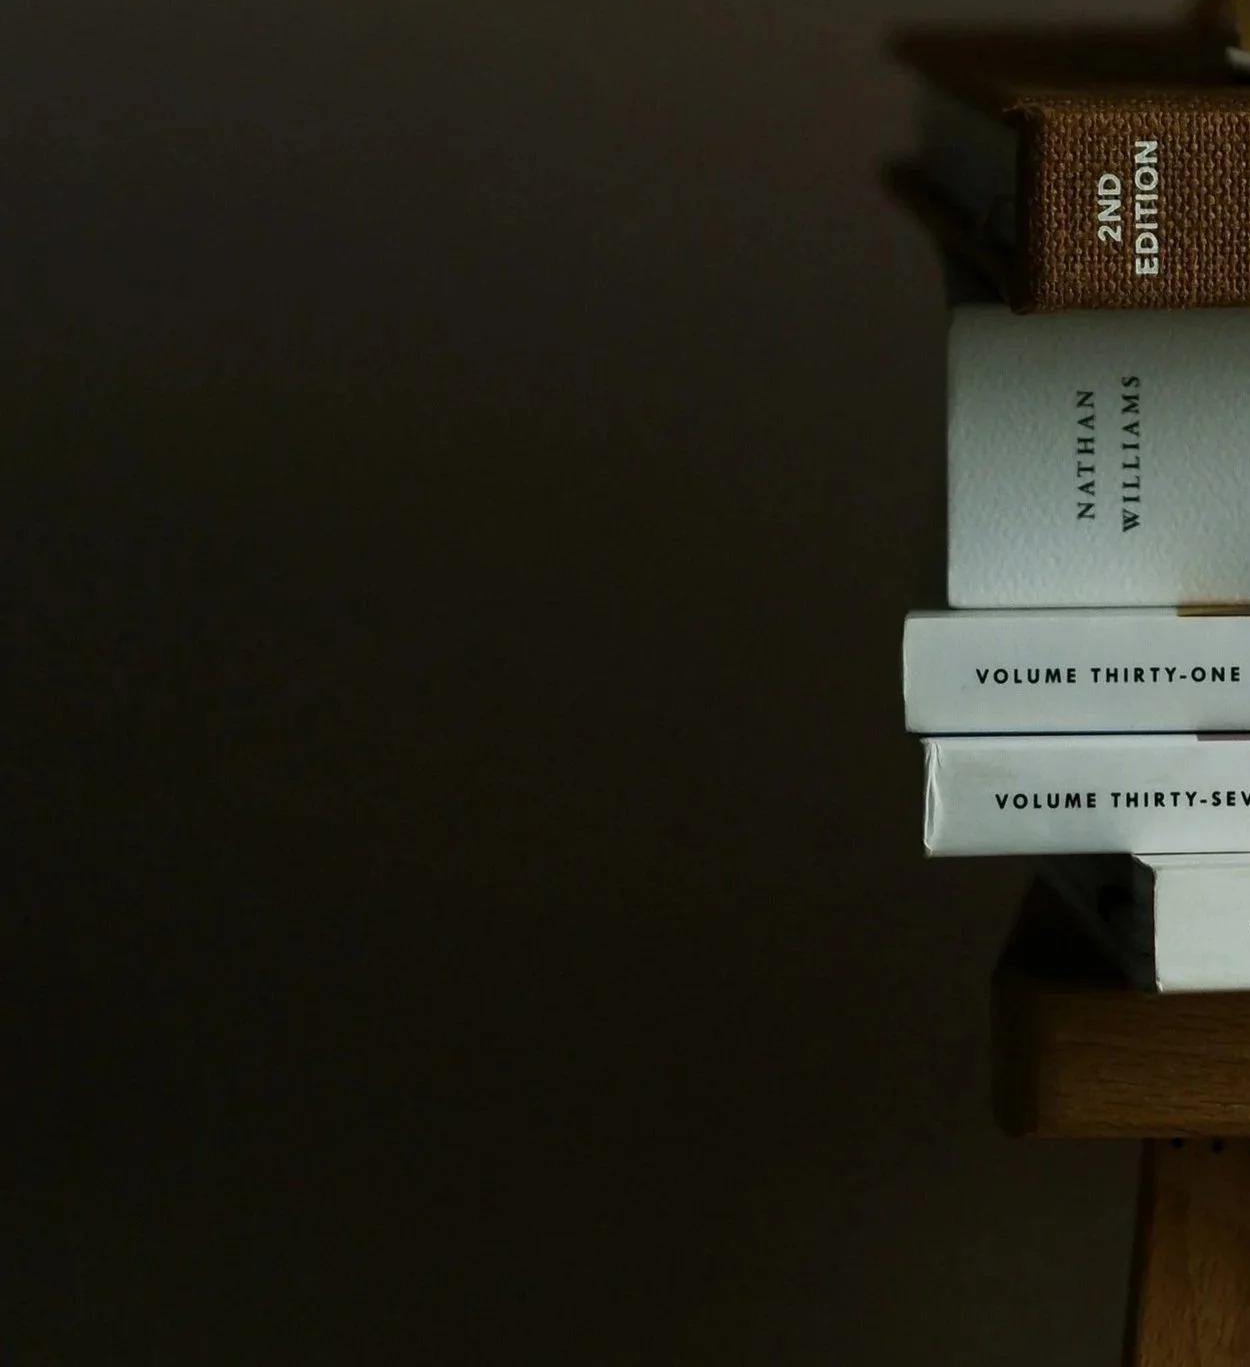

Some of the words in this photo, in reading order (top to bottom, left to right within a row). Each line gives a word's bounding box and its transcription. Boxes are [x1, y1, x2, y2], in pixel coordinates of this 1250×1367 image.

[1096, 173, 1123, 242] 2ND
[1134, 140, 1159, 275] EDITION
[1075, 389, 1097, 519] NATHAN
[1121, 374, 1143, 534] WILLIAMS
[975, 667, 1077, 685] VOLUME
[1090, 666, 1240, 684] THIRTY-ONE
[995, 792, 1097, 810] VOLUME
